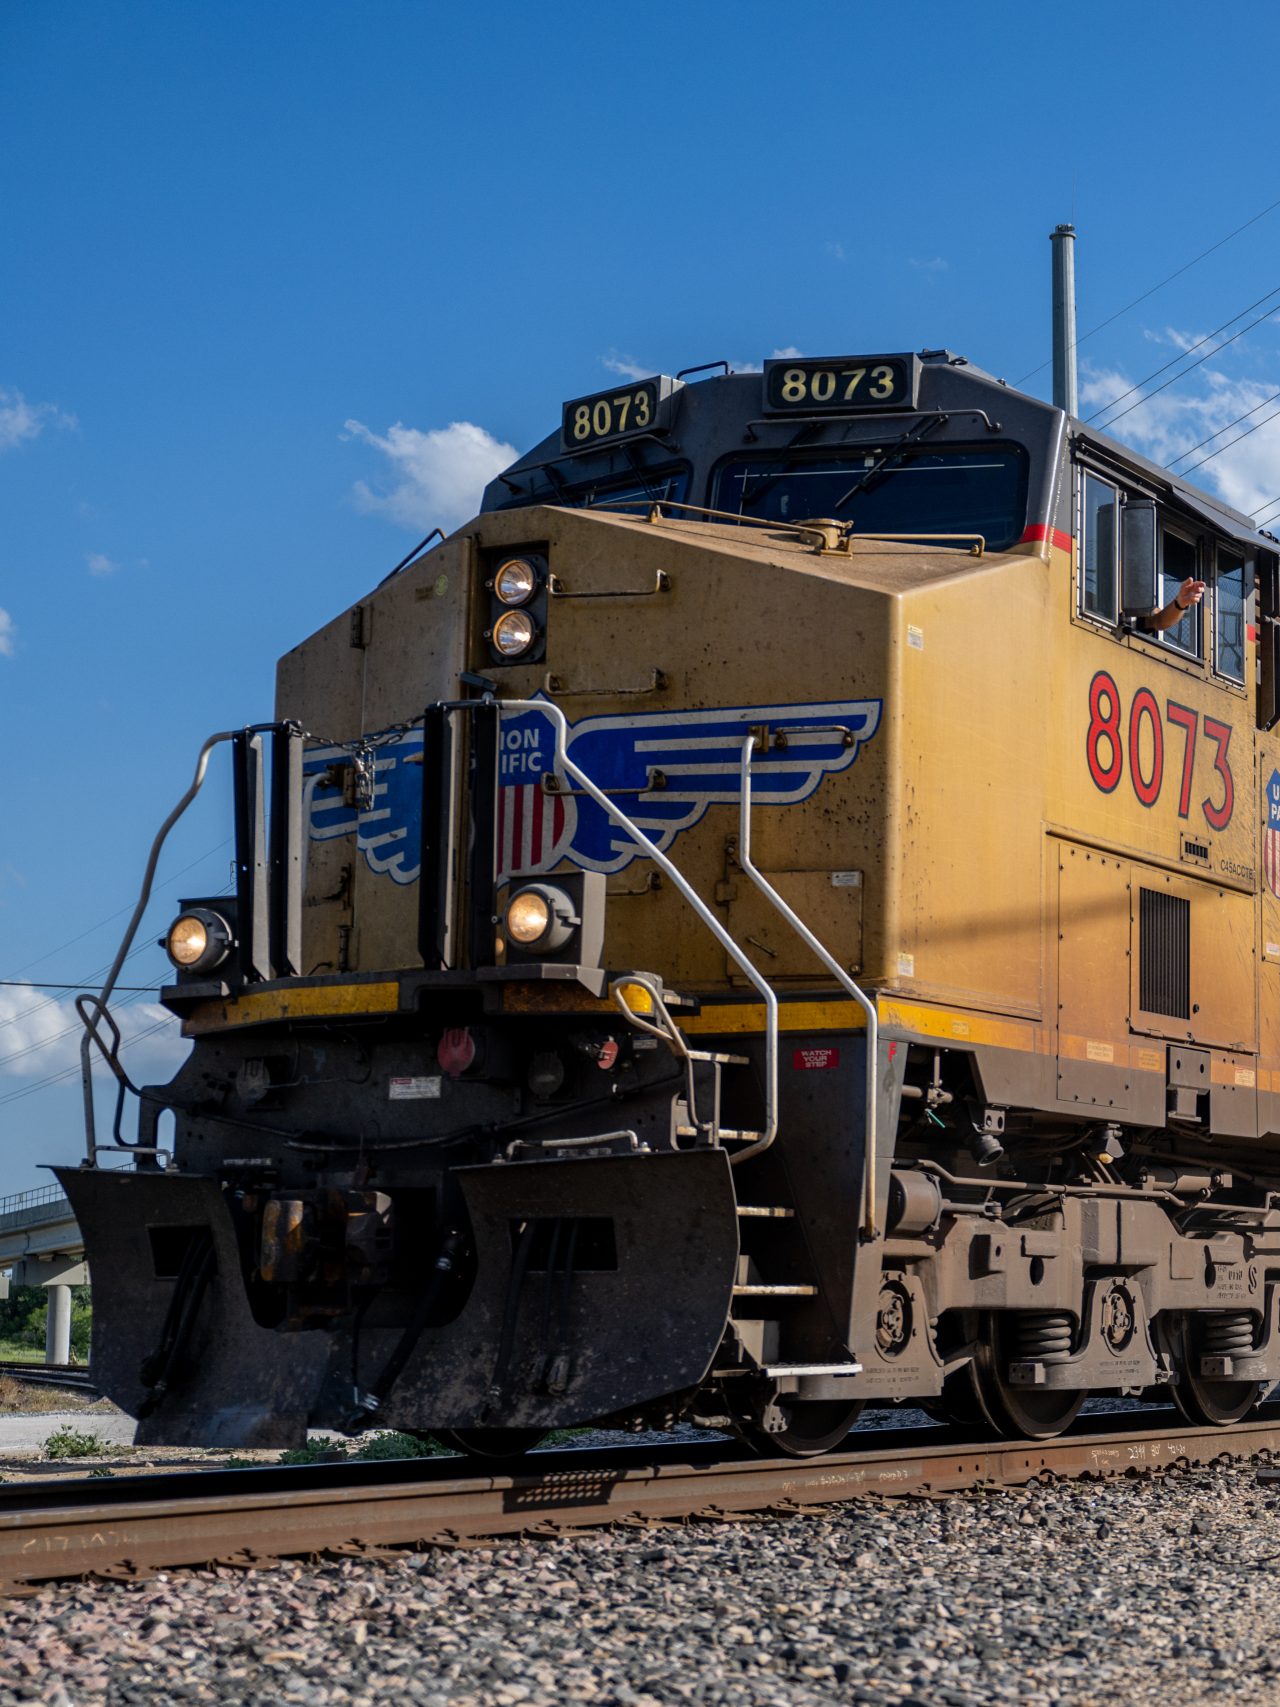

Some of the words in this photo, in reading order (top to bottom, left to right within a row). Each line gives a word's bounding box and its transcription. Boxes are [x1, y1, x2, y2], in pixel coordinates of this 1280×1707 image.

[782, 365, 895, 403] 8073
[573, 390, 650, 441] 8073
[1086, 670, 1235, 832] 8073
